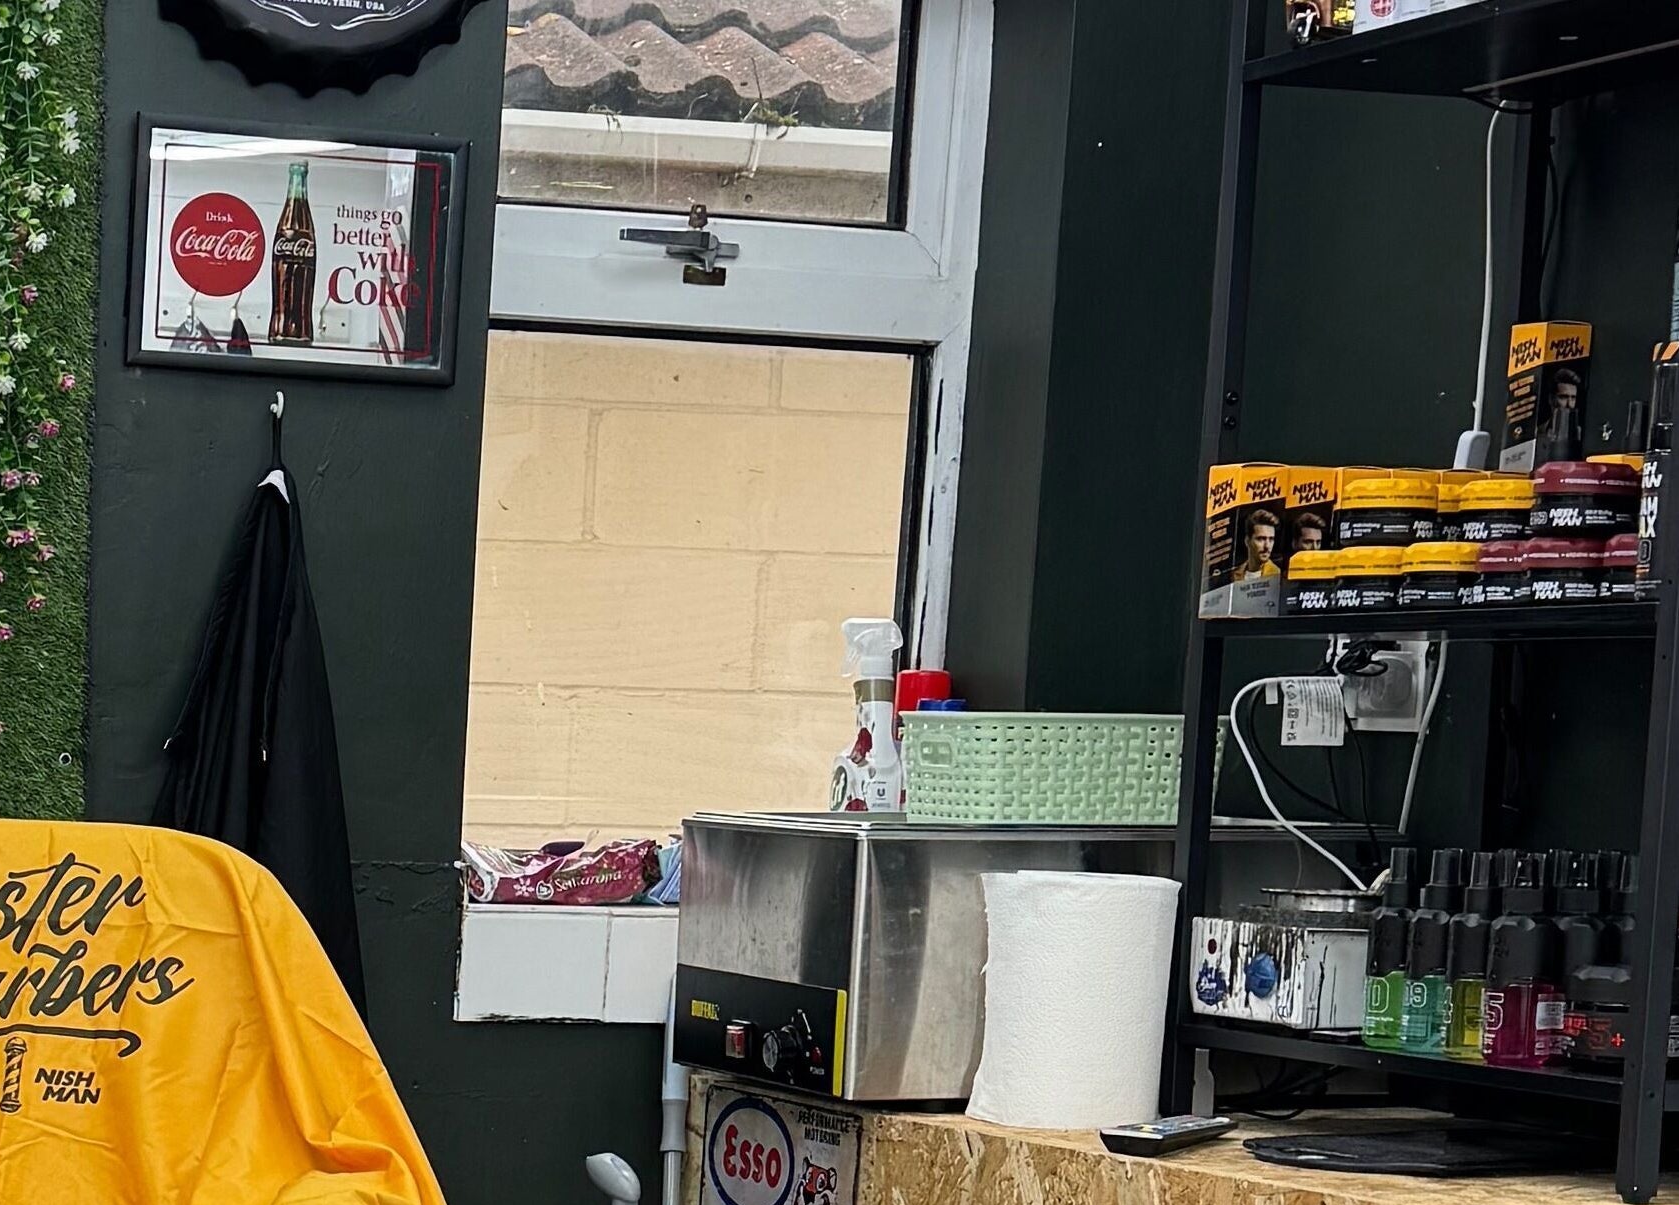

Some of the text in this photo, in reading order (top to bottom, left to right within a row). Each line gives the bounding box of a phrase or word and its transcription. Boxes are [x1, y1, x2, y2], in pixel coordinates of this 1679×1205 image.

[366, 1, 385, 11] USA
[205, 211, 234, 223] Drink
[337, 204, 403, 231] things go
[333, 222, 392, 248] better
[357, 243, 416, 277] with
[328, 266, 421, 309] Coke
[1511, 336, 1538, 357] NISH
[1550, 336, 1580, 351] NISH
[1555, 344, 1585, 360] MAN
[1515, 348, 1542, 369] MAN
[1210, 478, 1234, 499] NISH
[1246, 477, 1278, 492] NISH
[1252, 486, 1282, 502] MAN
[1292, 480, 1324, 496] NISH
[1212, 489, 1238, 511] MAN
[1298, 488, 1329, 505] MAN
[1549, 507, 1579, 519] NISH
[1551, 516, 1583, 527] MAN
[34, 1067, 97, 1088] NISH
[41, 1086, 102, 1105] MAN
[722, 1124, 782, 1188] ESSO
